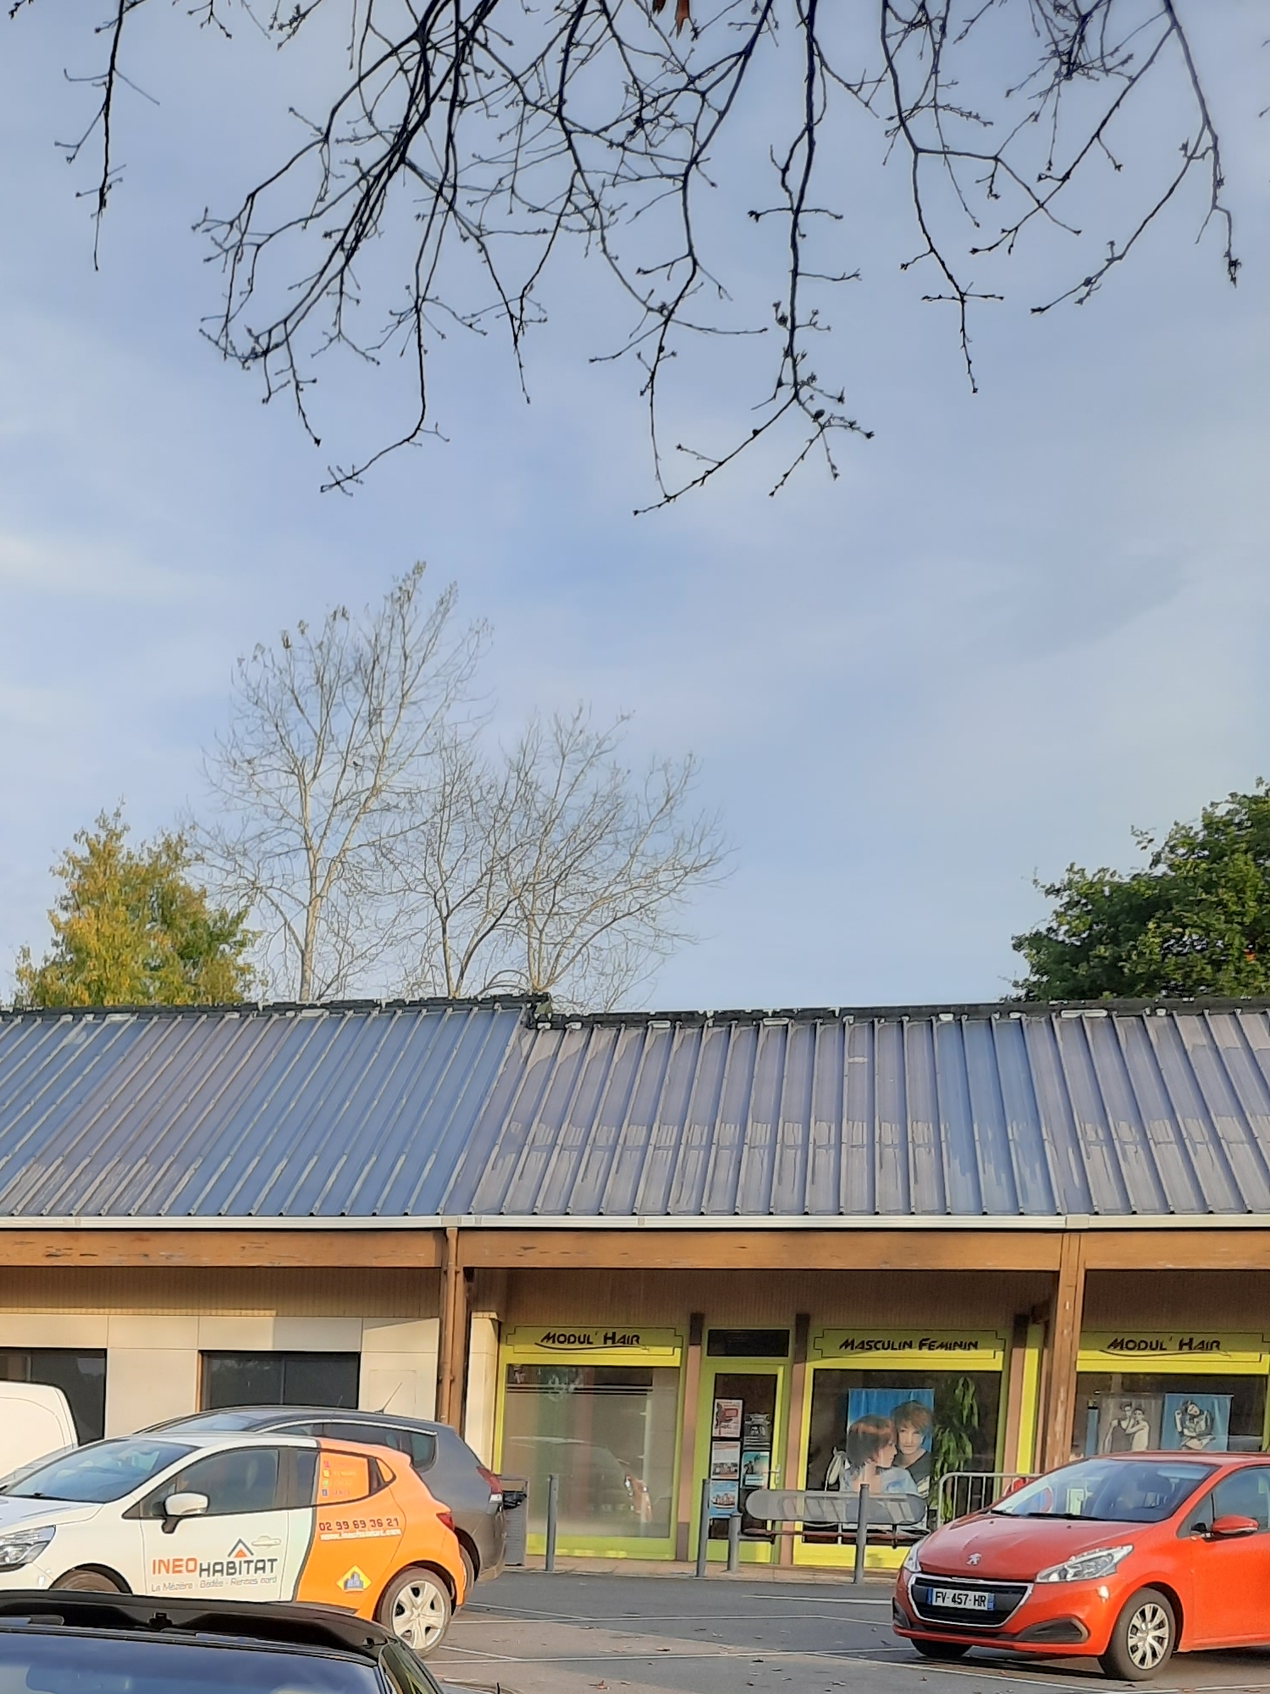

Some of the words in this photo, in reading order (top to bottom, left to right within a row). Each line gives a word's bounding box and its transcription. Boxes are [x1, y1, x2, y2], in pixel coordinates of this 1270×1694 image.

[603, 1331, 641, 1345] HAIR
[839, 1338, 913, 1351] MASCULIN
[918, 1338, 979, 1351] FEMININ
[1178, 1337, 1221, 1351] HAIR
[319, 1521, 333, 1531] 02
[335, 1520, 350, 1530] 99
[352, 1519, 367, 1529] 69
[369, 1518, 384, 1528] 36
[386, 1517, 399, 1527] 21
